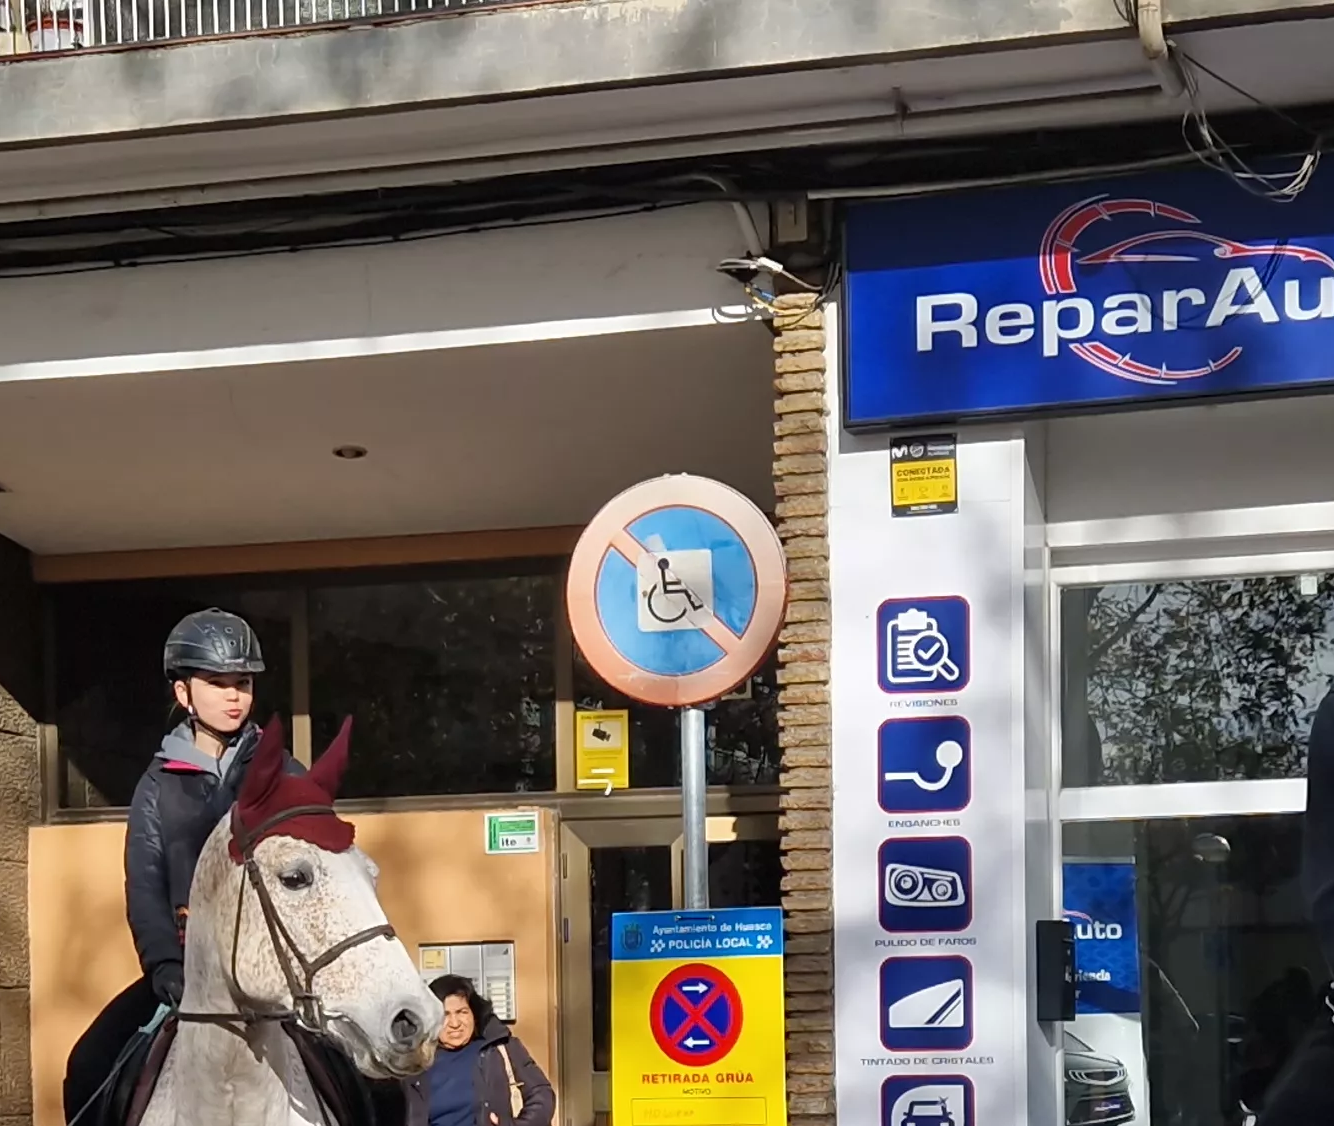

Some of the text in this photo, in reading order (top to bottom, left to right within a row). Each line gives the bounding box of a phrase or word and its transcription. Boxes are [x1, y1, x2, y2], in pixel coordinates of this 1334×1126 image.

[652, 924, 718, 936] Ayuntamiento
[720, 922, 732, 932] de
[668, 936, 754, 949] POLICÍA LOCAL
[874, 936, 977, 947] PULIDO DE FAROS
[860, 1056, 995, 1067] TINTADO DE CRISTALES
[641, 1070, 755, 1085] RETIRADA GRÚA
